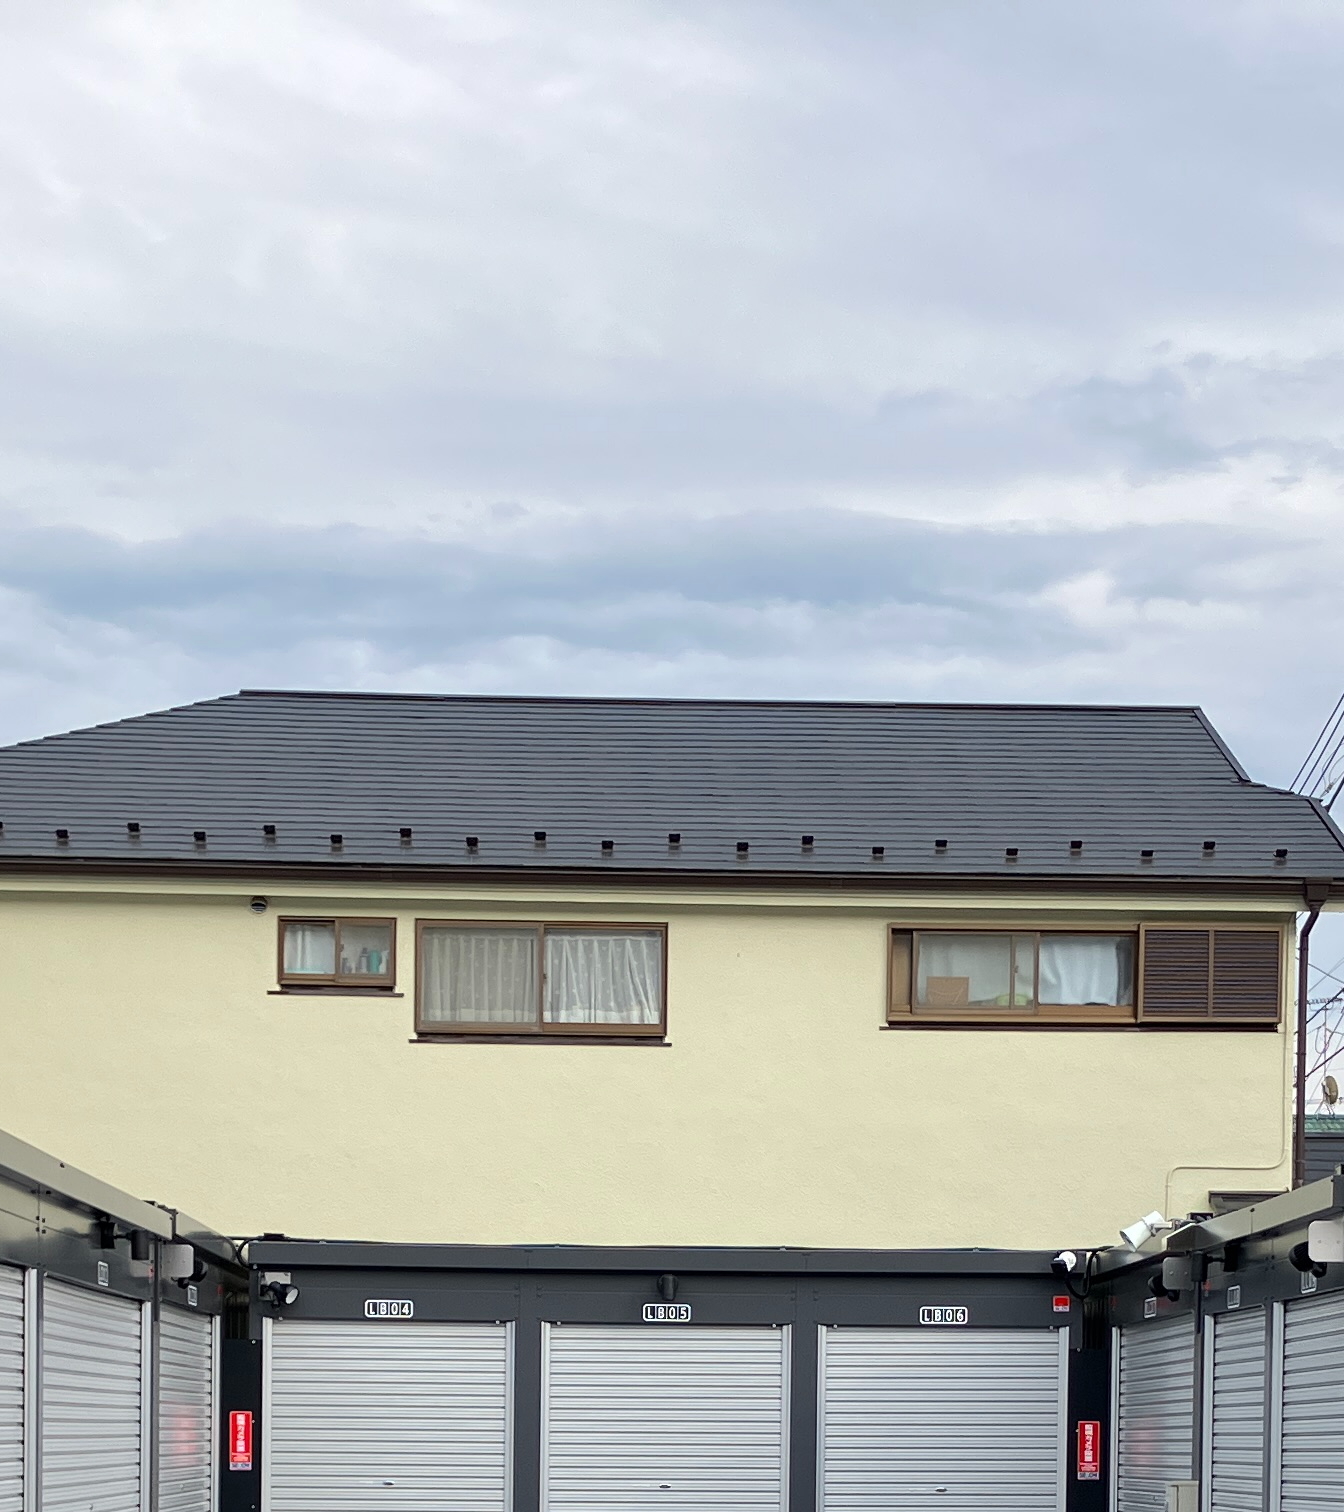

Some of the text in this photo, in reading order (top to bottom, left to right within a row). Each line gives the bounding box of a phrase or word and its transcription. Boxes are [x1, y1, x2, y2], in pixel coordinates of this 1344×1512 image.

[369, 1302, 409, 1315] LB04
[647, 1307, 687, 1319] LB05
[925, 1309, 964, 1321] LB06
